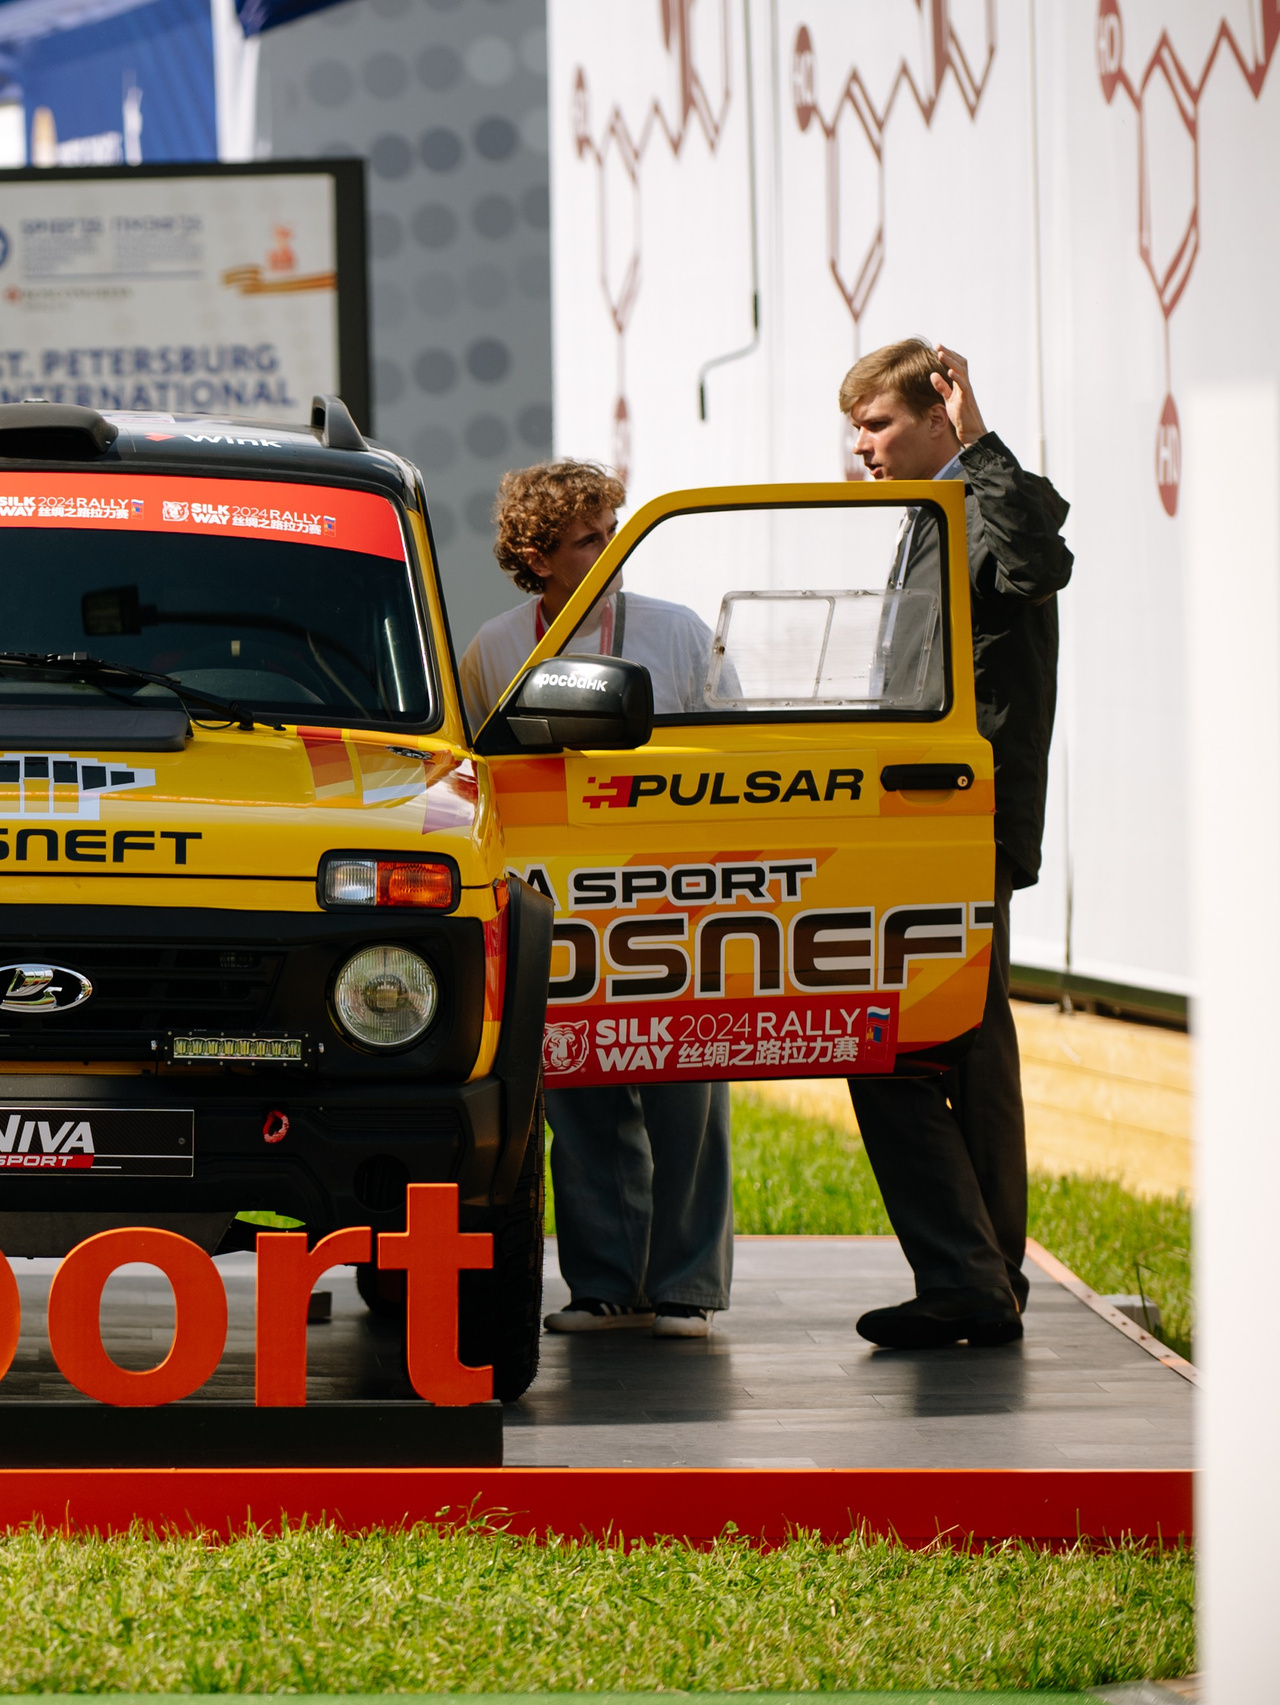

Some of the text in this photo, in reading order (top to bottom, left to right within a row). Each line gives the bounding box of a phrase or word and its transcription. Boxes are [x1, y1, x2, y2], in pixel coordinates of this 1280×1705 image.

[41, 343, 279, 376] PETERSBURG
[38, 497, 74, 507] 2024
[77, 498, 128, 509] RALLY
[38, 506, 129, 519] 丝绸之路拉力赛
[191, 503, 321, 525] SILK 2024 RALLY
[192, 513, 231, 525] WAY
[232, 516, 322, 535] 丝绸之路拉力赛
[627, 768, 865, 808] PULSAR
[571, 860, 815, 908] SPORT
[595, 1008, 861, 1045] SILK 2024 RALLY
[595, 1045, 674, 1072] WAY
[676, 1037, 859, 1068] 丝绸之路拉力赛
